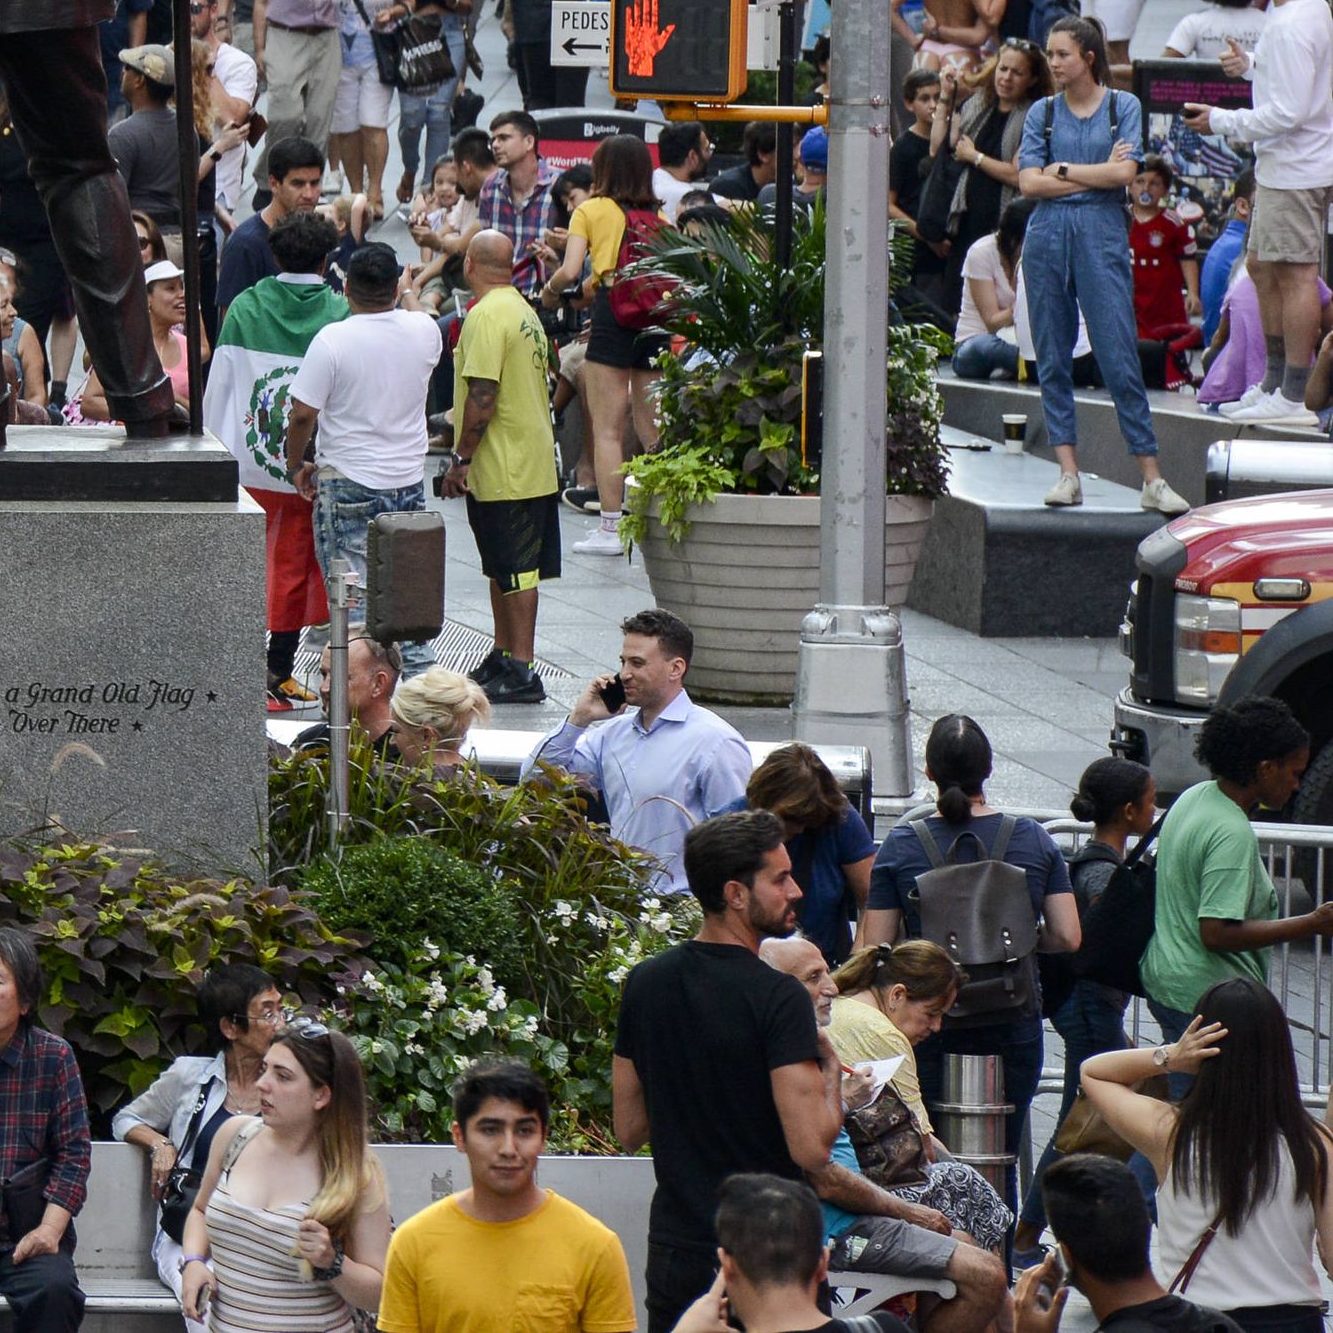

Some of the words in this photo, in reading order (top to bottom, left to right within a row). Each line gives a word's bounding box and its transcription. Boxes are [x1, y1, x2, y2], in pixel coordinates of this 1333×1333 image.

[583, 122, 620, 138] Bigbelly
[4, 686, 21, 702] a
[25, 680, 95, 712] Grand
[101, 680, 142, 705] Old
[146, 680, 196, 712] Flag
[10, 709, 61, 734] Over
[67, 709, 121, 735] There
